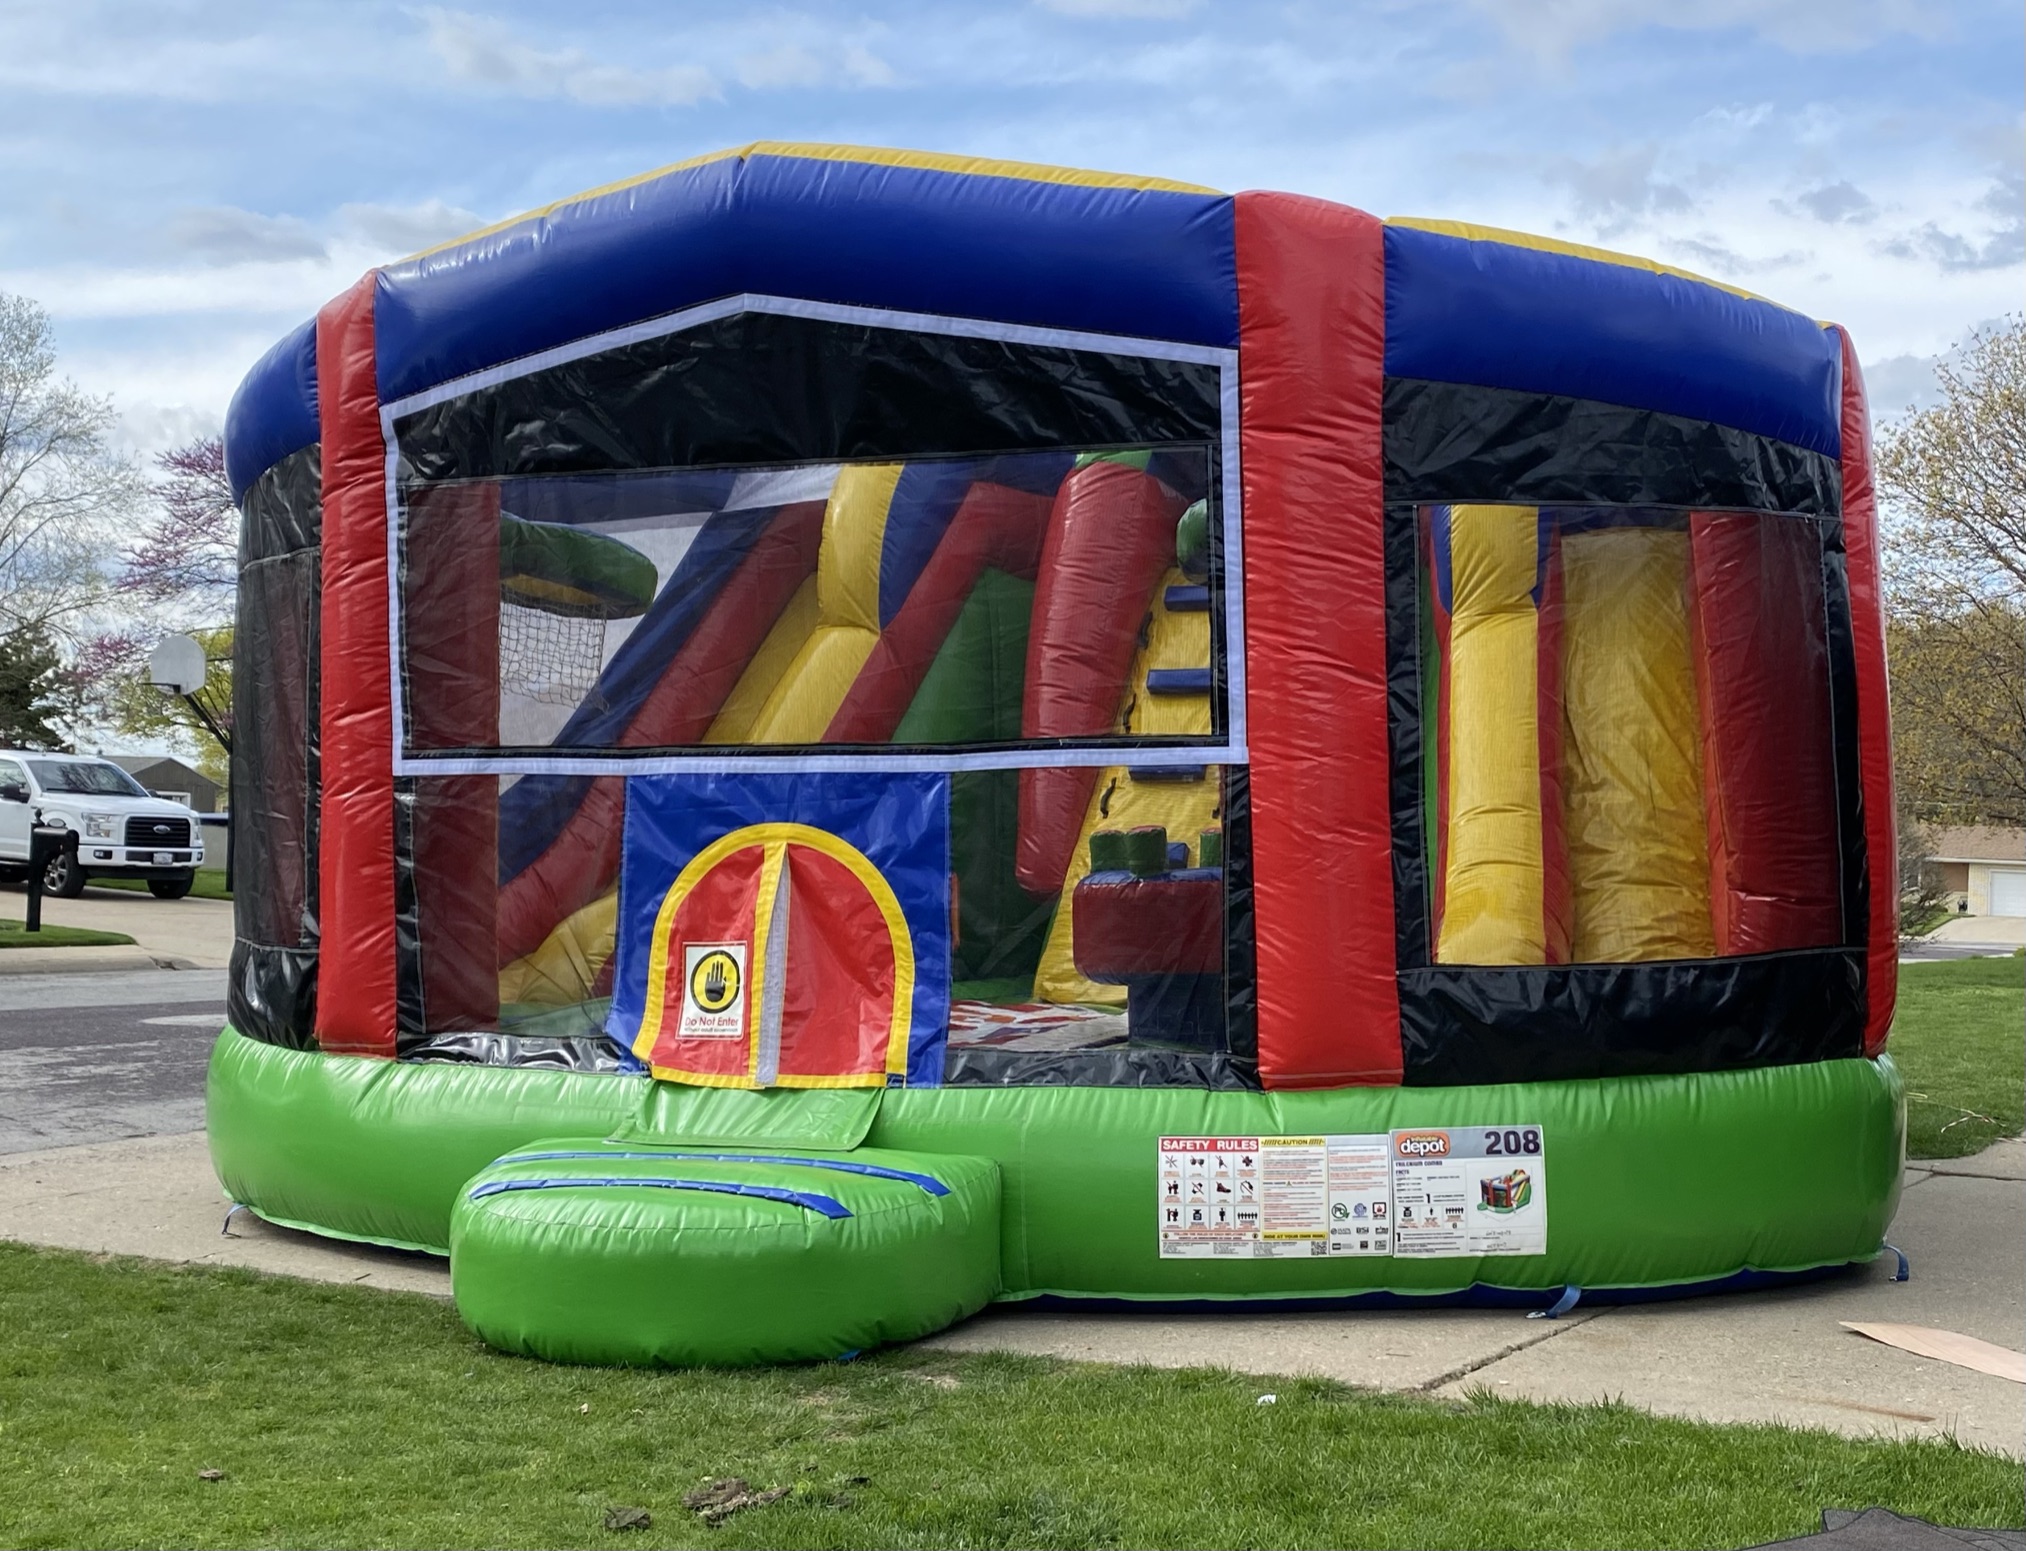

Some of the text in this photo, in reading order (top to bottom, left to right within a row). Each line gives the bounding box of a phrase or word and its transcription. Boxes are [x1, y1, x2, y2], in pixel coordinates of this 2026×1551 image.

[685, 1017, 738, 1026] Do Not Enter
[1162, 1140, 1258, 1150] SAFETY RULES
[1400, 1138, 1445, 1156] depot
[1485, 1130, 1540, 1155] 208
